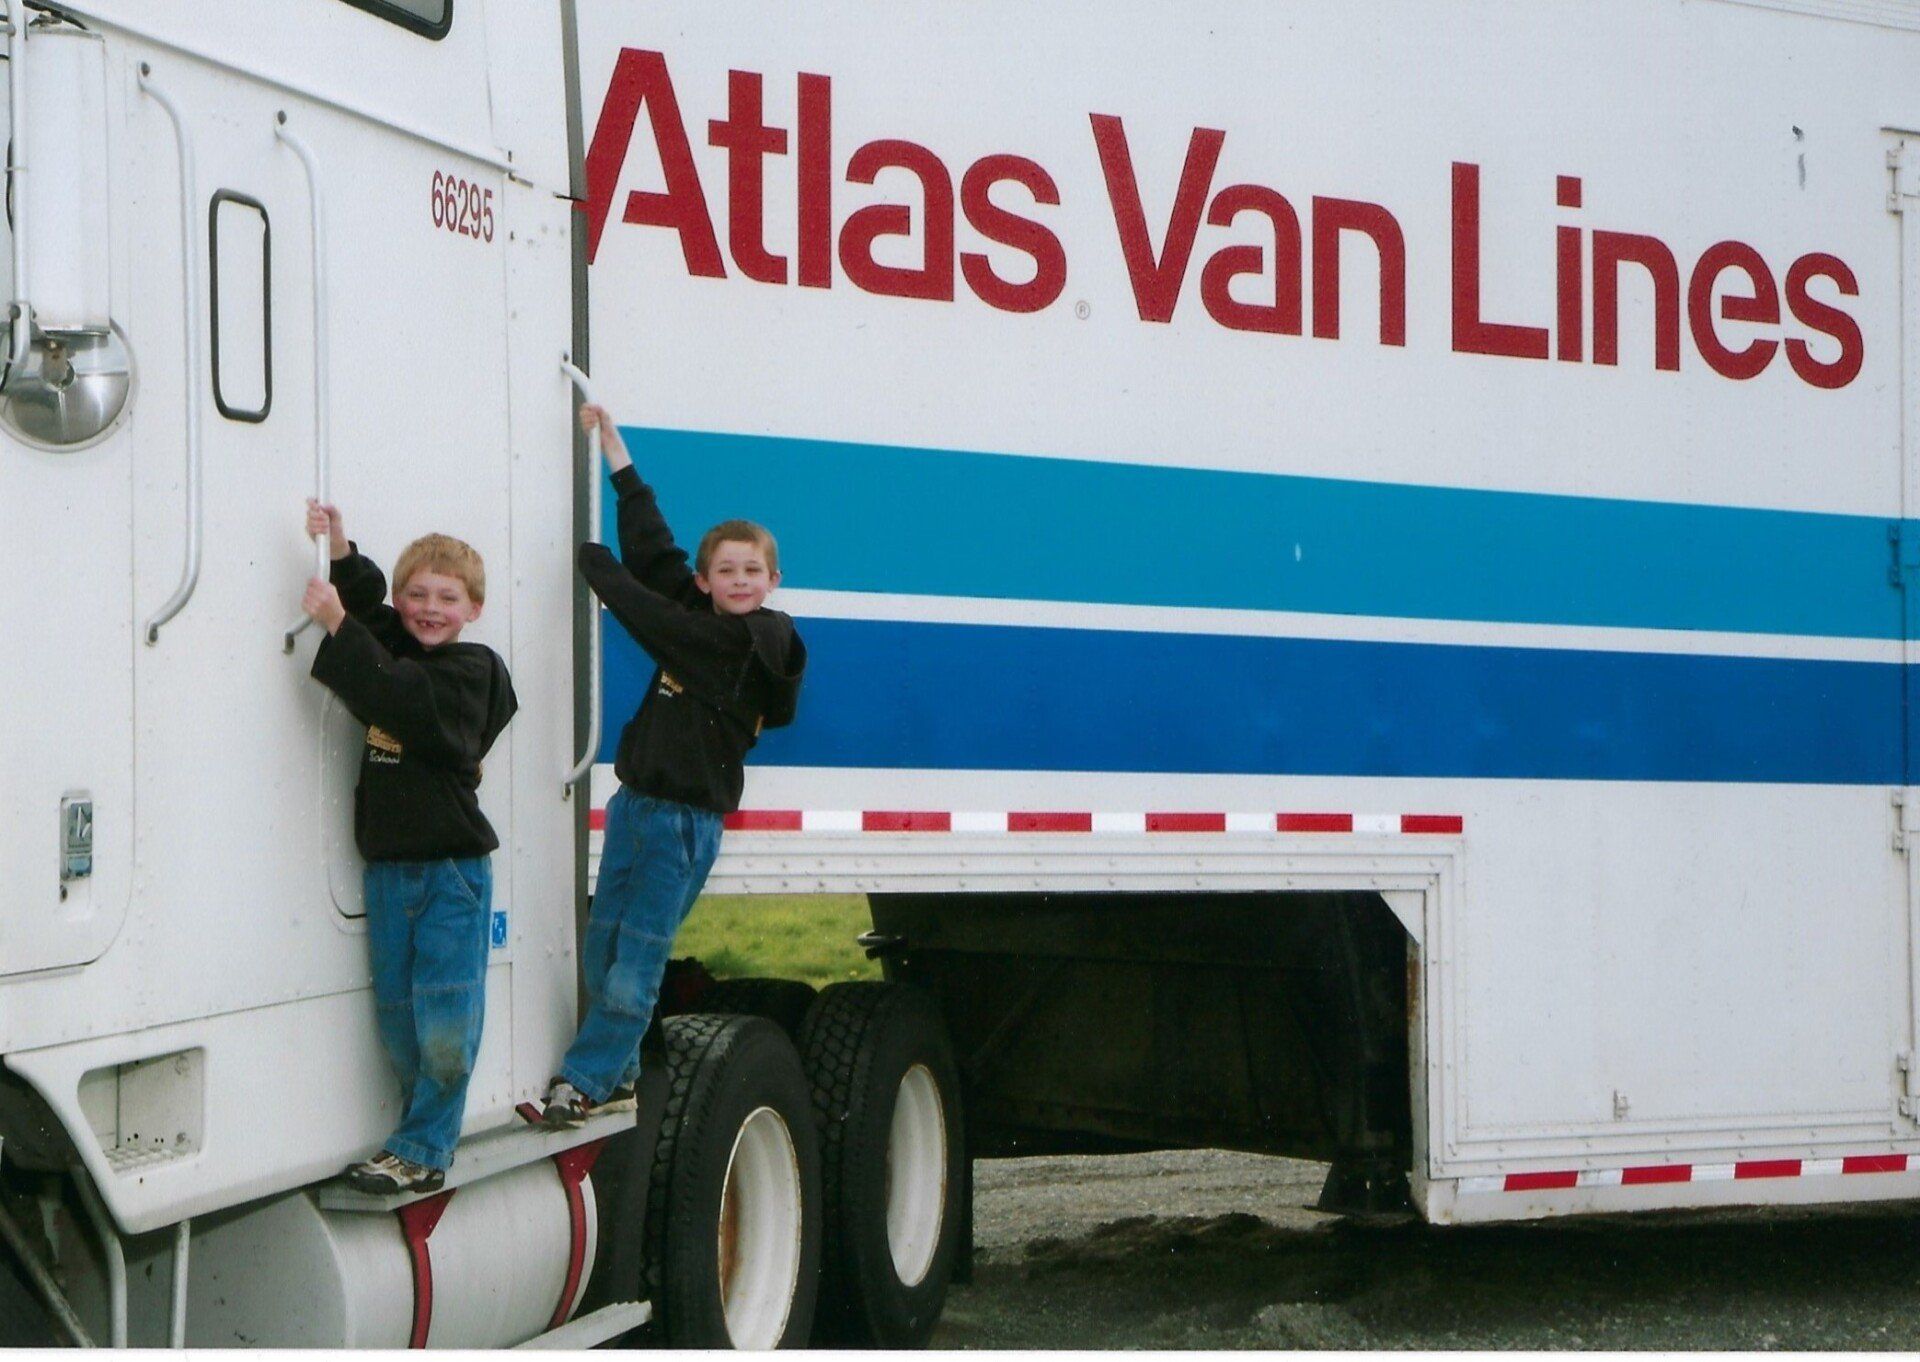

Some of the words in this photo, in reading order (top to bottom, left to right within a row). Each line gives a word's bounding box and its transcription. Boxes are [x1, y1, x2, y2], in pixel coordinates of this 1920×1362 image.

[432, 170, 494, 243] 66295
[584, 48, 1067, 313] Atlas
[1091, 115, 1406, 346] Van
[1452, 164, 1863, 389] Lines
